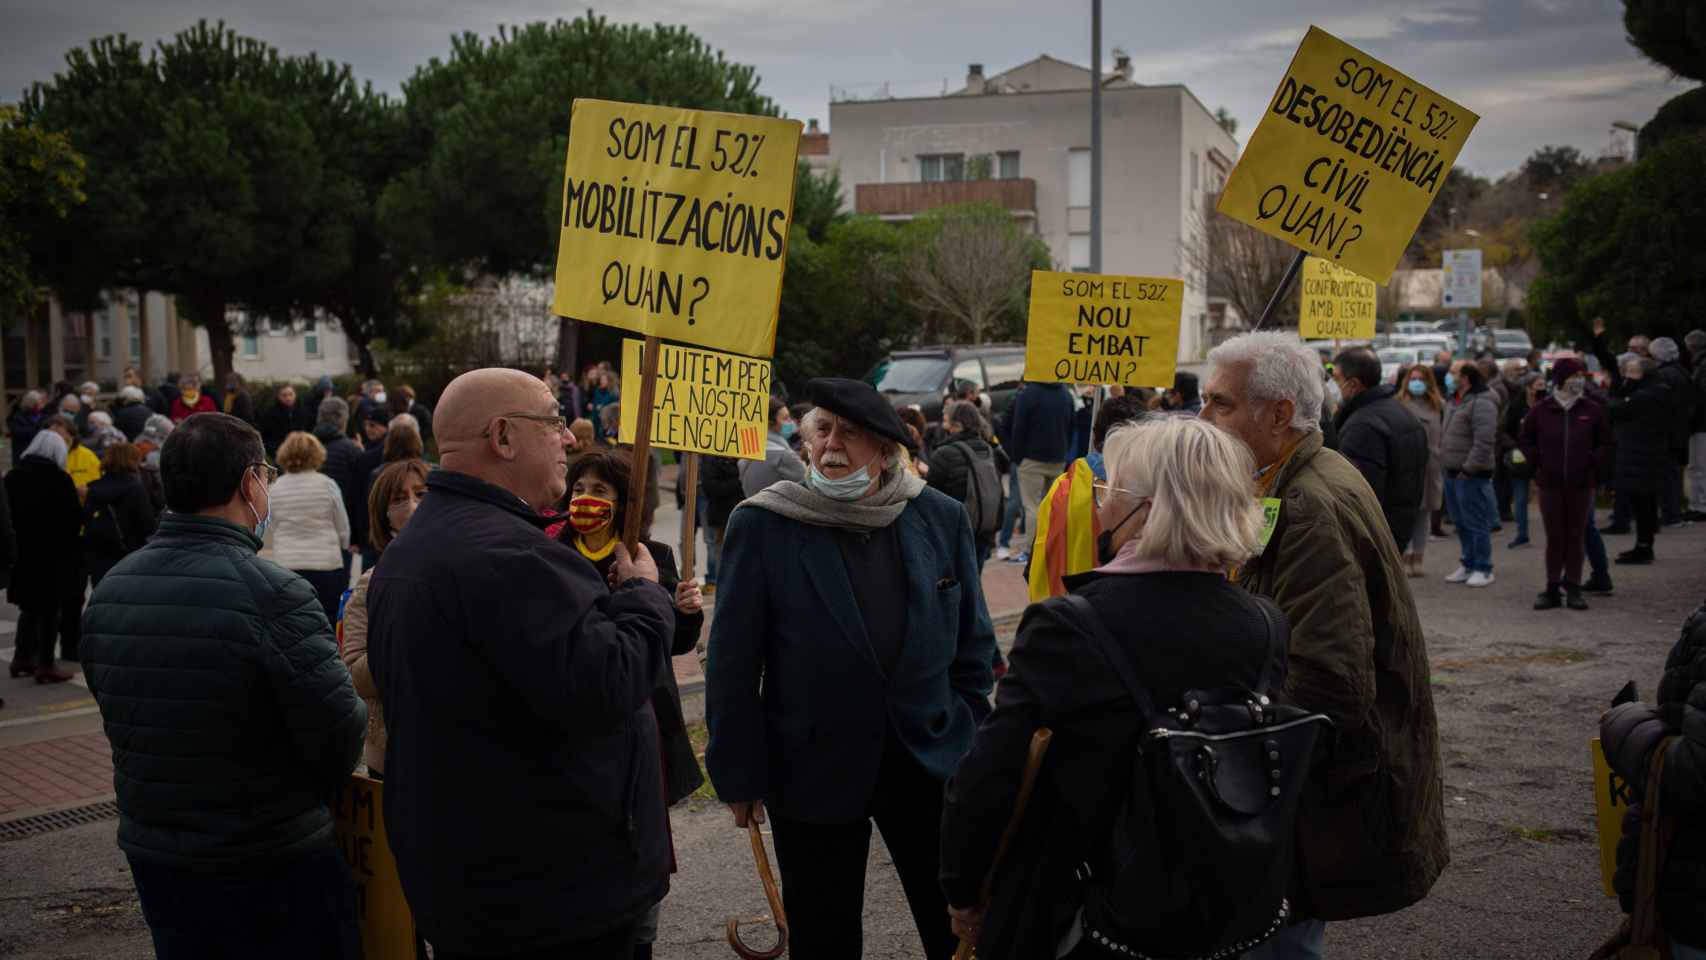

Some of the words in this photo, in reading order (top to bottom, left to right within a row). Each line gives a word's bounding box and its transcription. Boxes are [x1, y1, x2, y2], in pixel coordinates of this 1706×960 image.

[1335, 58, 1393, 107] SOM
[1391, 86, 1418, 125] EL
[1420, 104, 1458, 141] 52%
[606, 118, 667, 165] SOM
[670, 126, 701, 170] EL
[711, 130, 766, 178] 52%
[1256, 185, 1363, 260] QUAN?
[601, 261, 710, 326] QUAN?
[1063, 279, 1104, 298] SOM
[1112, 282, 1131, 300] EL
[1137, 283, 1168, 302] 52%
[1078, 304, 1131, 328] NOU
[1309, 301, 1333, 318] AMB
[1068, 333, 1150, 357] EMBAT
[738, 361, 770, 393] PER
[1055, 358, 1137, 384] QUAN?
[688, 385, 763, 423] NOSTRA
